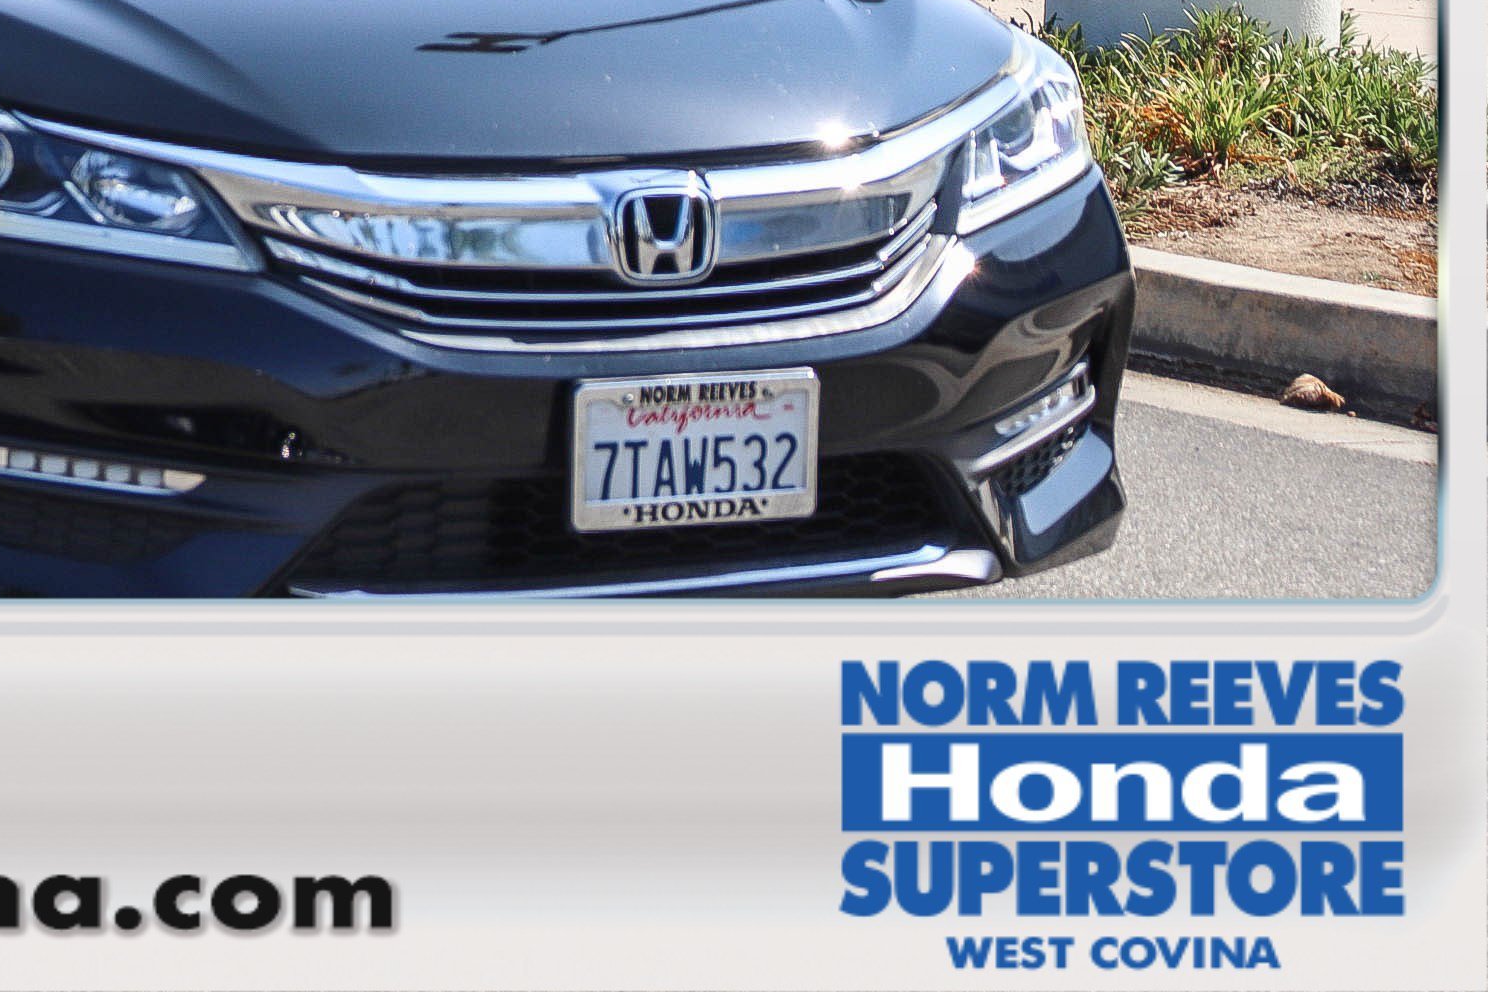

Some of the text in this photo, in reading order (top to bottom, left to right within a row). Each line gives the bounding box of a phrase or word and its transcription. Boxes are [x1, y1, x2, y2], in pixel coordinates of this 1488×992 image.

[639, 380, 757, 405] NORM REEVES
[626, 401, 772, 435] California
[594, 431, 799, 502] 7TAW532
[633, 497, 761, 524] HONDA
